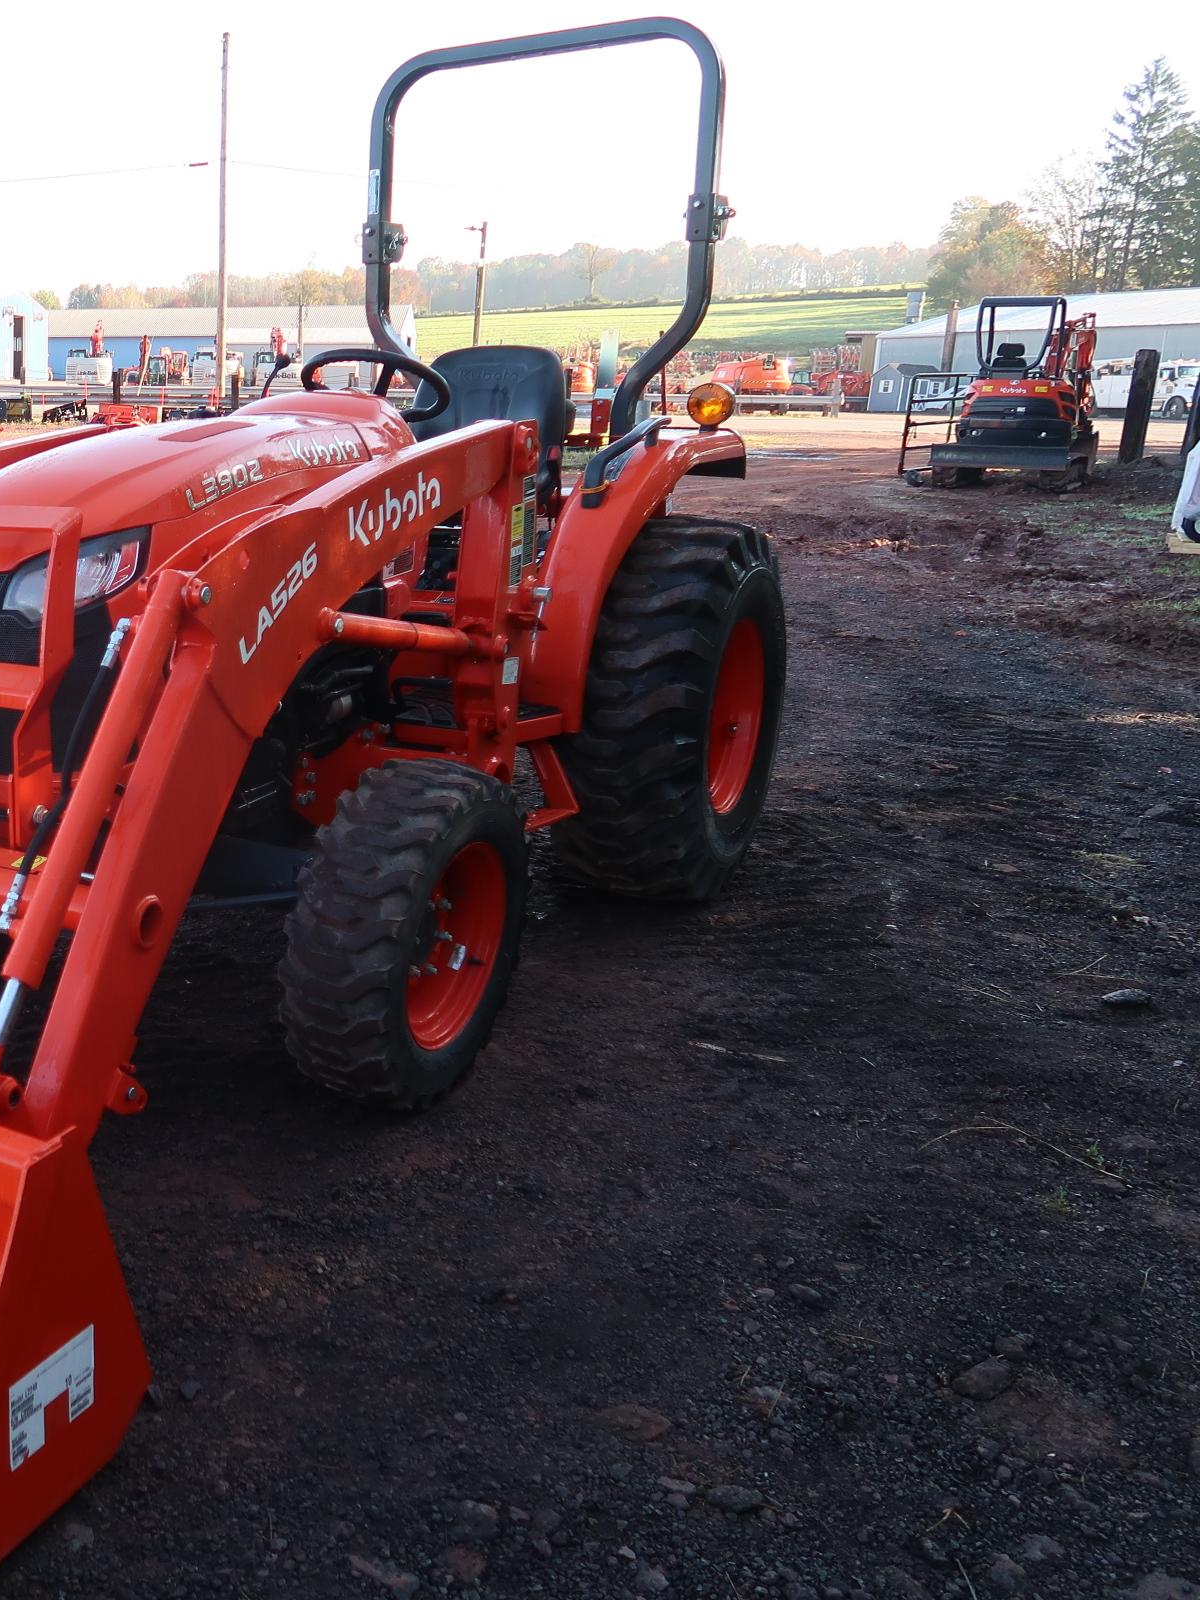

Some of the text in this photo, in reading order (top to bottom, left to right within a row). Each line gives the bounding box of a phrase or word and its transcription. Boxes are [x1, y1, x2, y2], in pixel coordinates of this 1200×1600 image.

[287, 434, 360, 467] Kubota
[184, 459, 264, 511] L3902
[348, 471, 442, 547] Kubota
[239, 541, 318, 665] LA526
